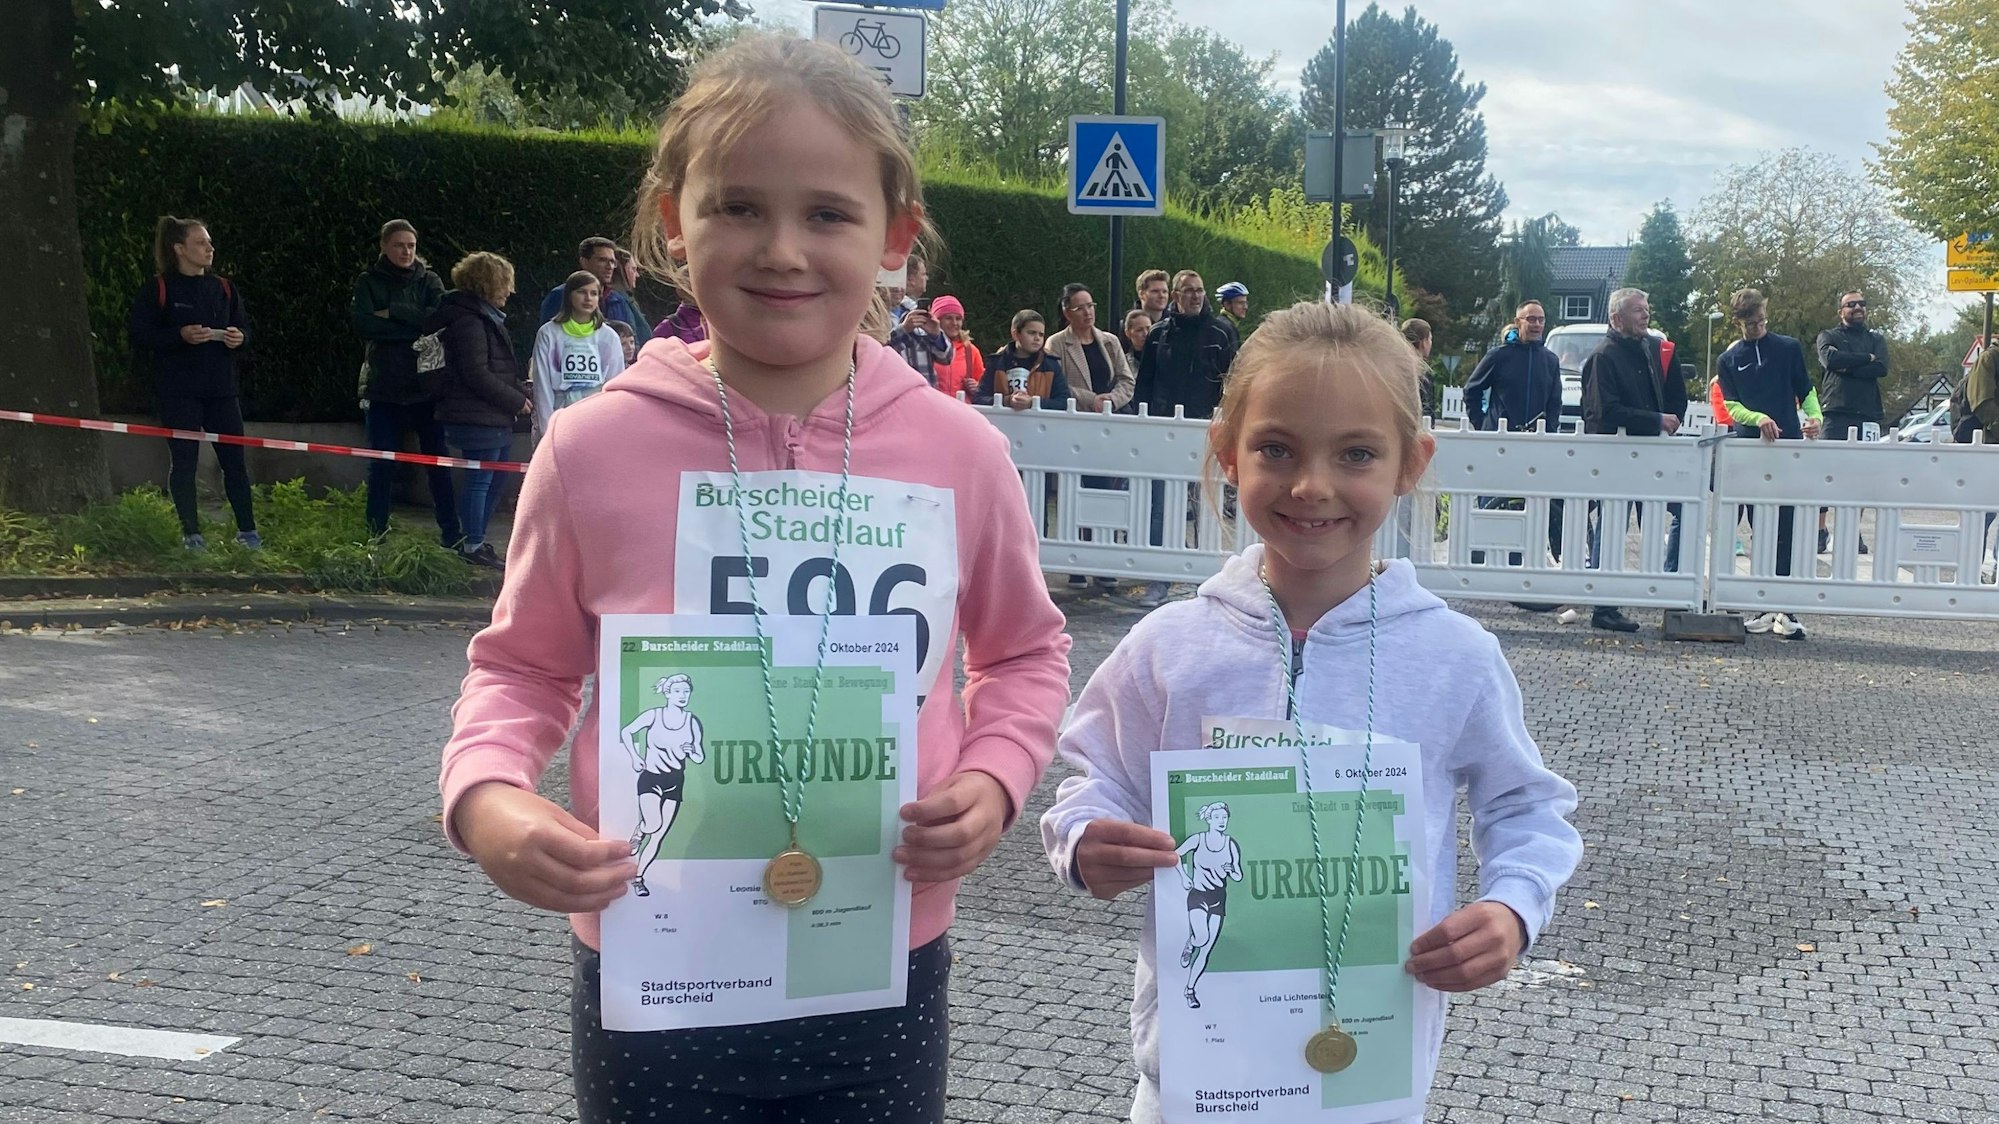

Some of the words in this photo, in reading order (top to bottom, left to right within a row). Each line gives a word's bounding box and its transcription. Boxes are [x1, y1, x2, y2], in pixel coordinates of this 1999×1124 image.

[565, 354, 598, 372] 636
[695, 482, 874, 511] Burscheider
[751, 510, 907, 548] Stadtlauf
[641, 640, 710, 653] Burscheider
[713, 640, 761, 652] Stadtlau
[830, 642, 872, 654] Oktober
[874, 642, 899, 653] 2024
[769, 676, 788, 688] ine
[710, 737, 896, 785] URKUNDE
[1185, 772, 1242, 784] Burscheider
[1245, 769, 1289, 782] Stadtlauf
[1385, 767, 1407, 777] 2024
[1355, 799, 1398, 812] Bwegung
[1247, 854, 1409, 901] URKUNDE
[641, 976, 772, 992] Stadtsportverband
[641, 992, 713, 1006] Burscheid
[1259, 994, 1282, 1003] Linda
[1284, 992, 1331, 1002] Lichtenstei
[1195, 1084, 1310, 1101] Stadtsportverband
[1196, 1101, 1259, 1113] Burscheid
